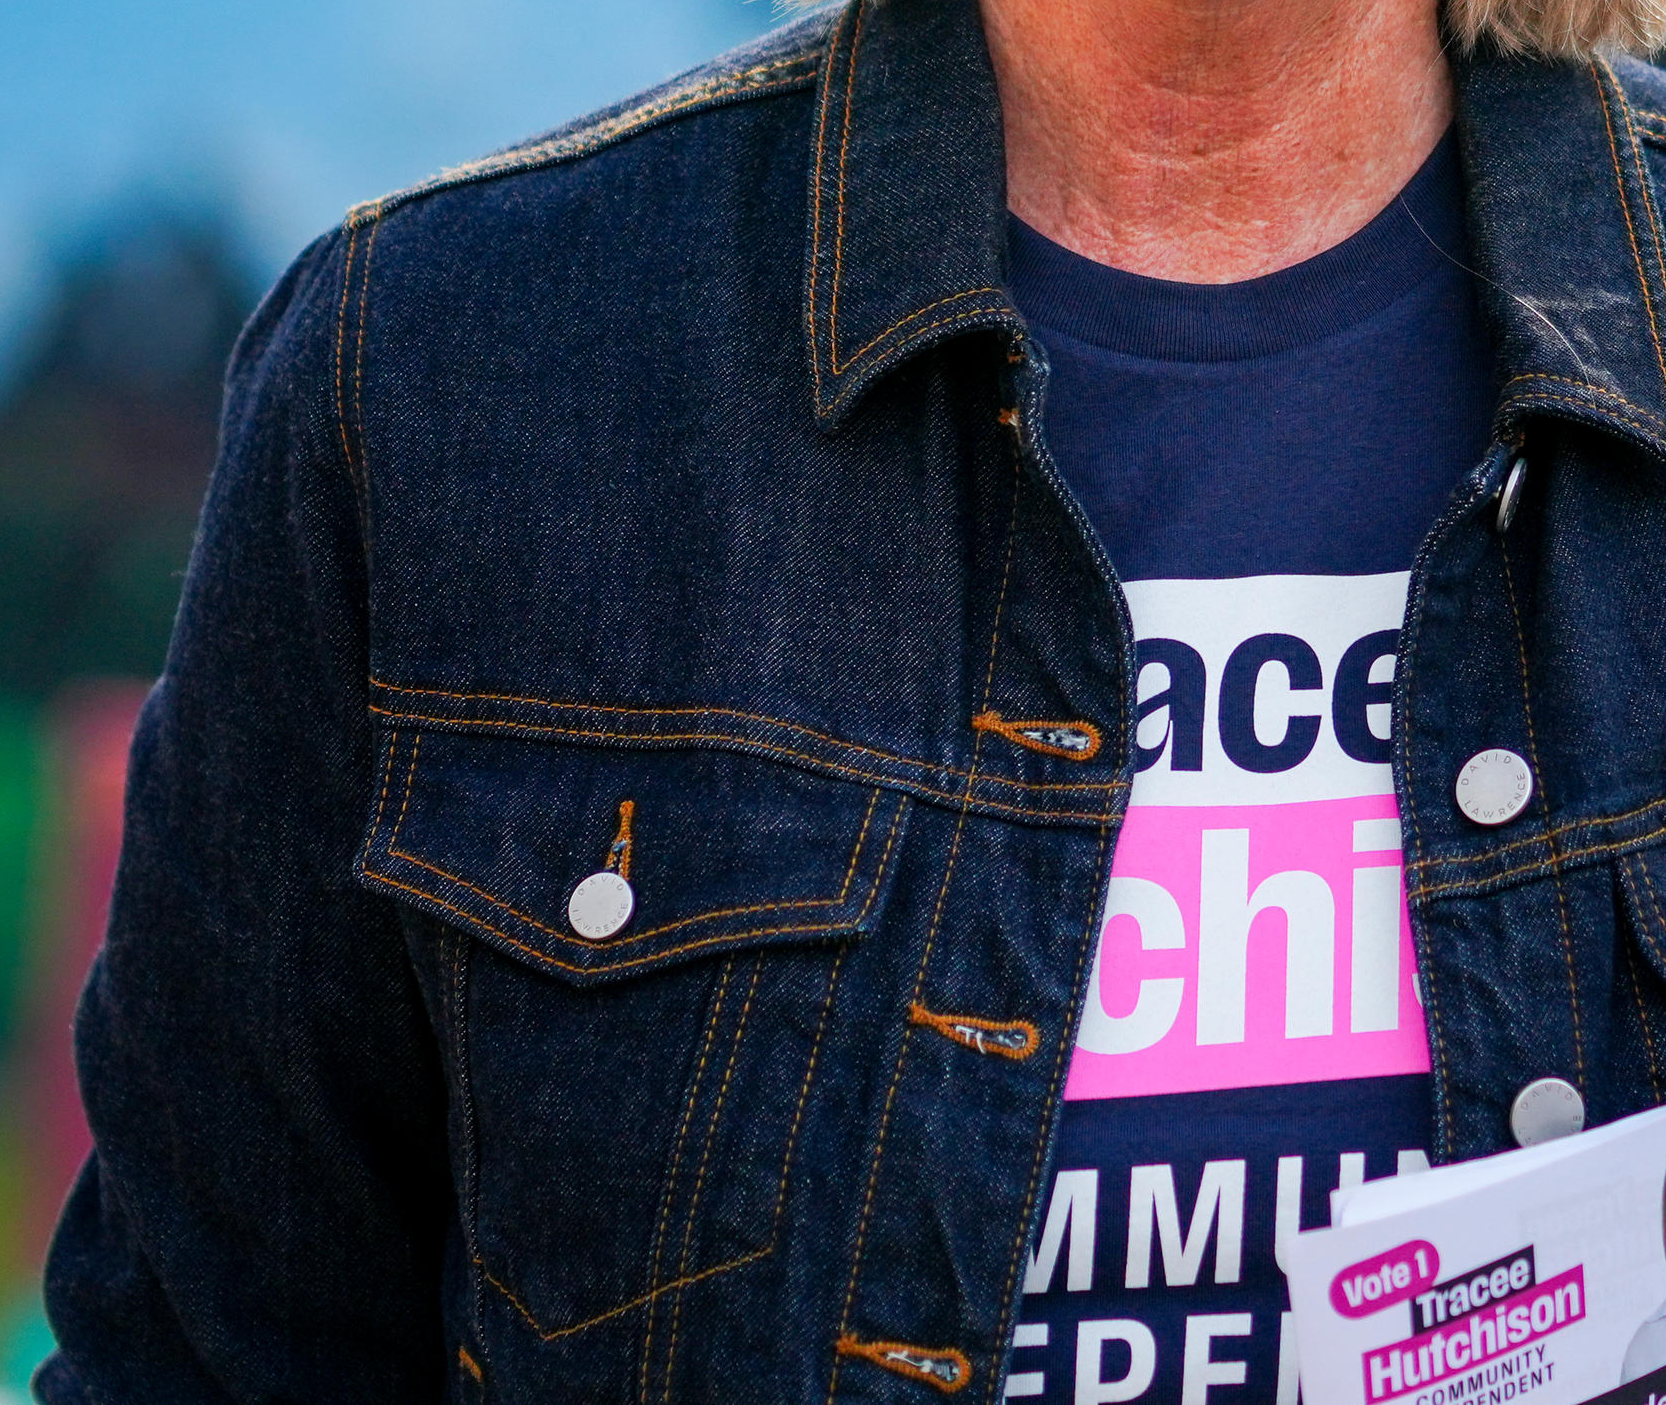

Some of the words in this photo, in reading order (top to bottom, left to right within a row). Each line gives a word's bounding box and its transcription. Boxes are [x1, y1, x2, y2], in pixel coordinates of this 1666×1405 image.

[1461, 754, 1512, 785] DAVID
[1464, 773, 1526, 818] LAWRENCE
[1075, 817, 1424, 1055] chi
[1341, 1261, 1411, 1308] Vote
[1414, 1248, 1429, 1279] 1
[1415, 1257, 1531, 1328] Tracee
[1369, 1281, 1581, 1399] Hutchison
[1416, 1344, 1546, 1405] COMMUNITY
